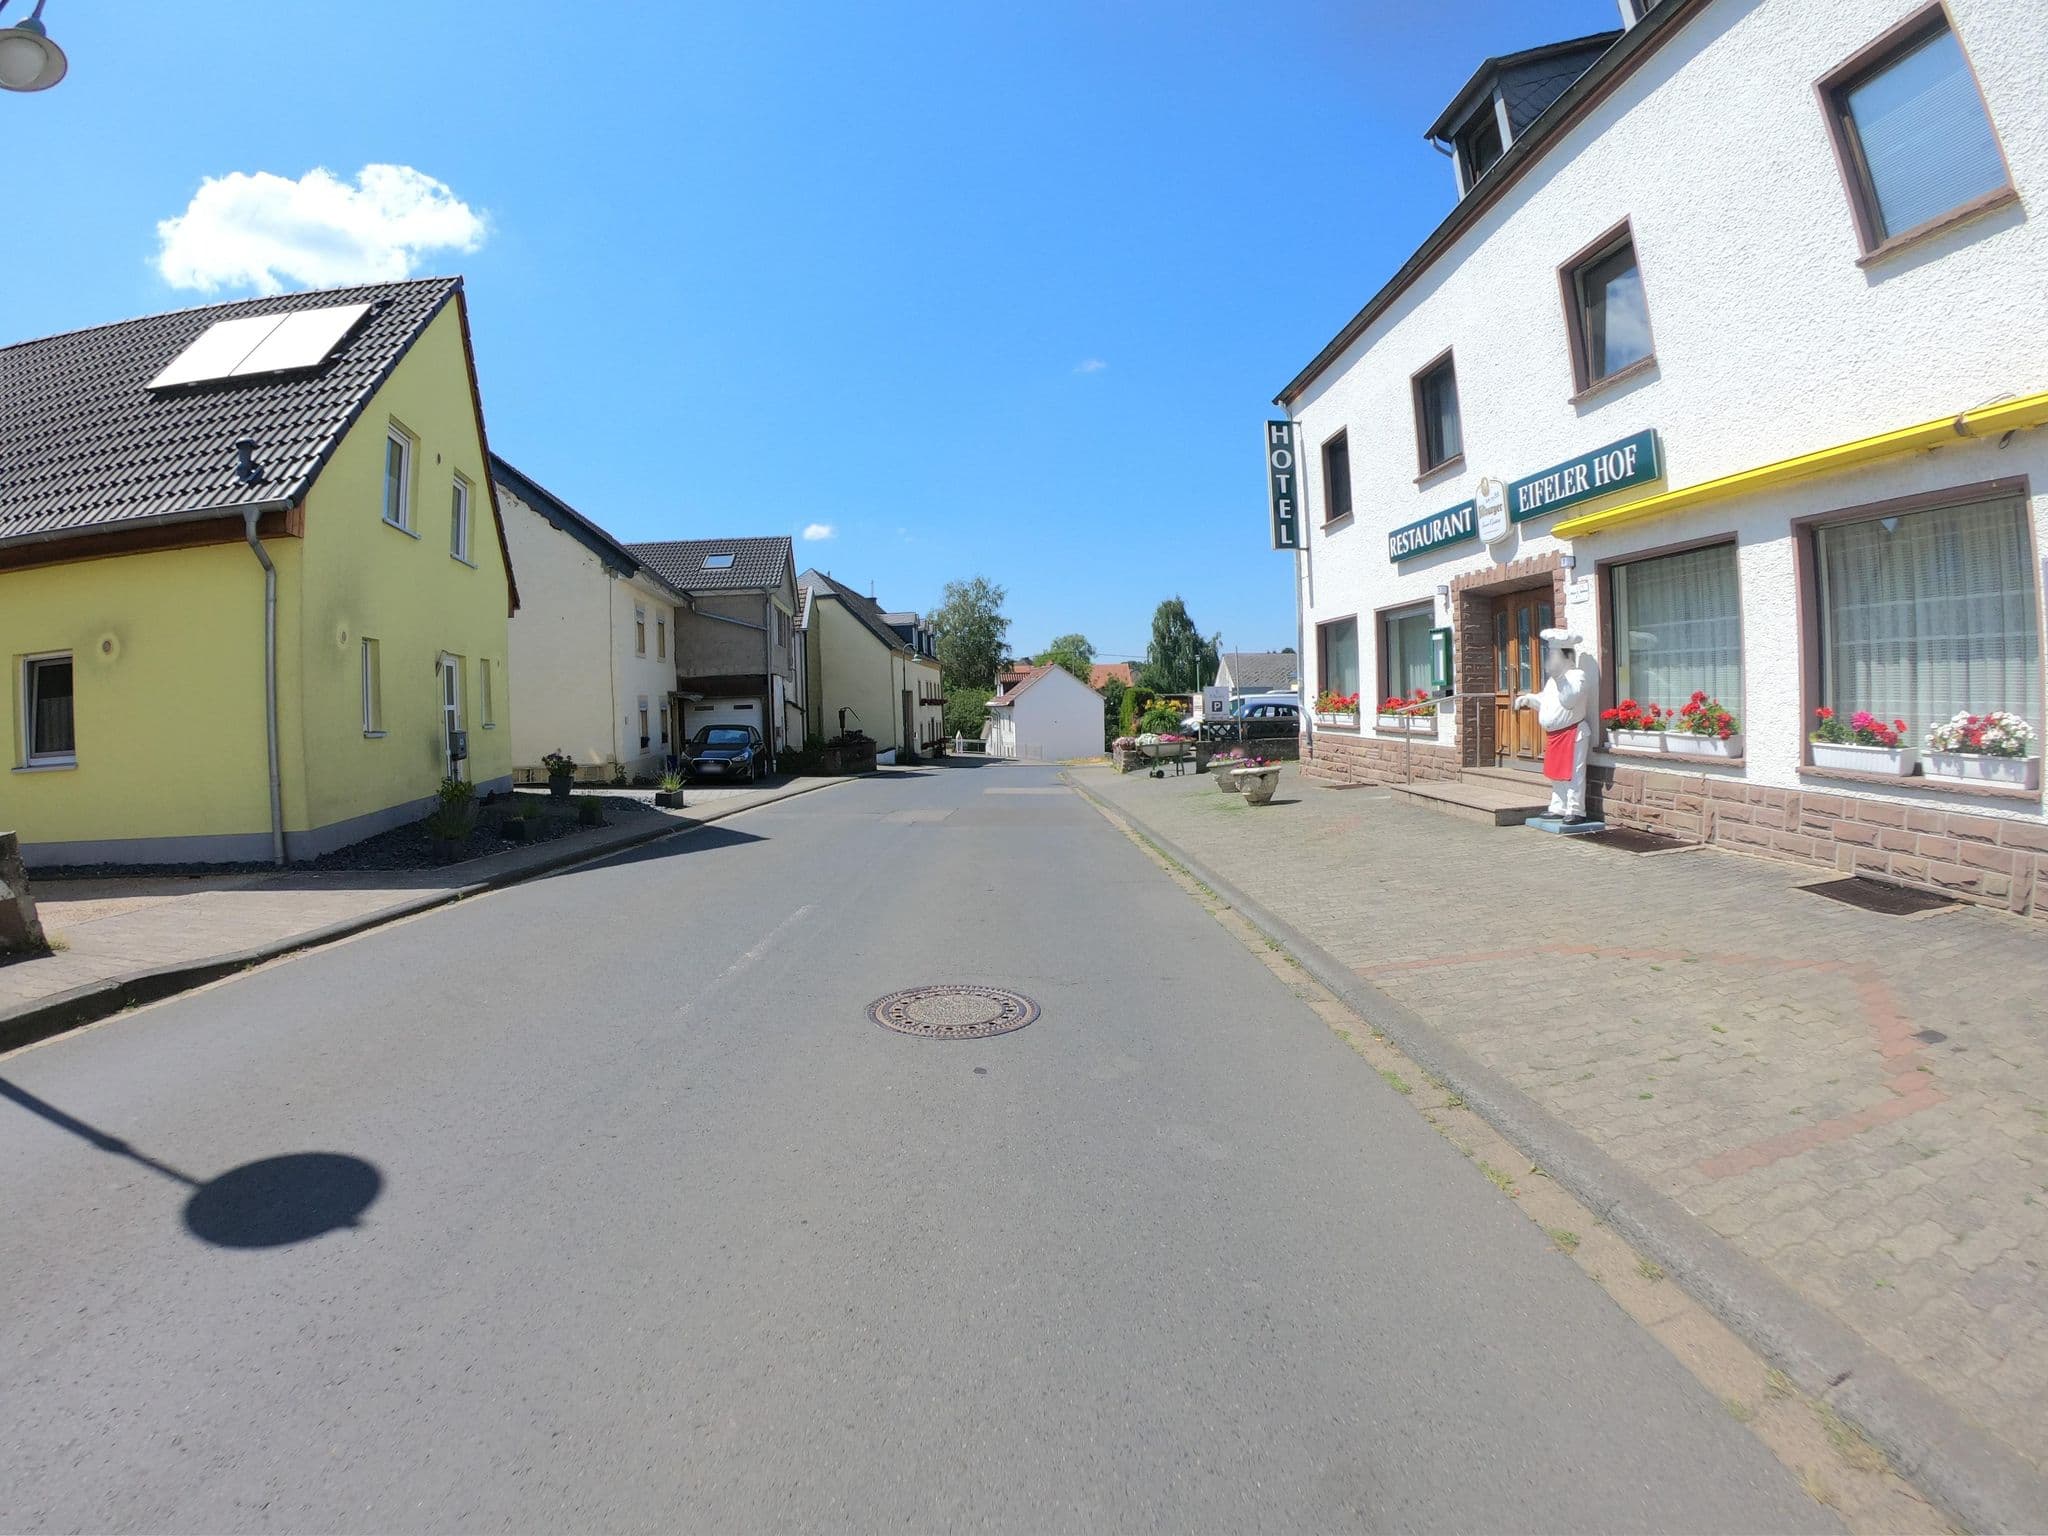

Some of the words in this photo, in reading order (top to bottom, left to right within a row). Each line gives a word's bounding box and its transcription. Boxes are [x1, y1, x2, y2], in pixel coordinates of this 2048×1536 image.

[1270, 425, 1293, 544] HOTEL
[1517, 463, 1590, 513] EIFELER
[1593, 443, 1637, 488] HOF
[1390, 507, 1472, 557] RESTAURANT
